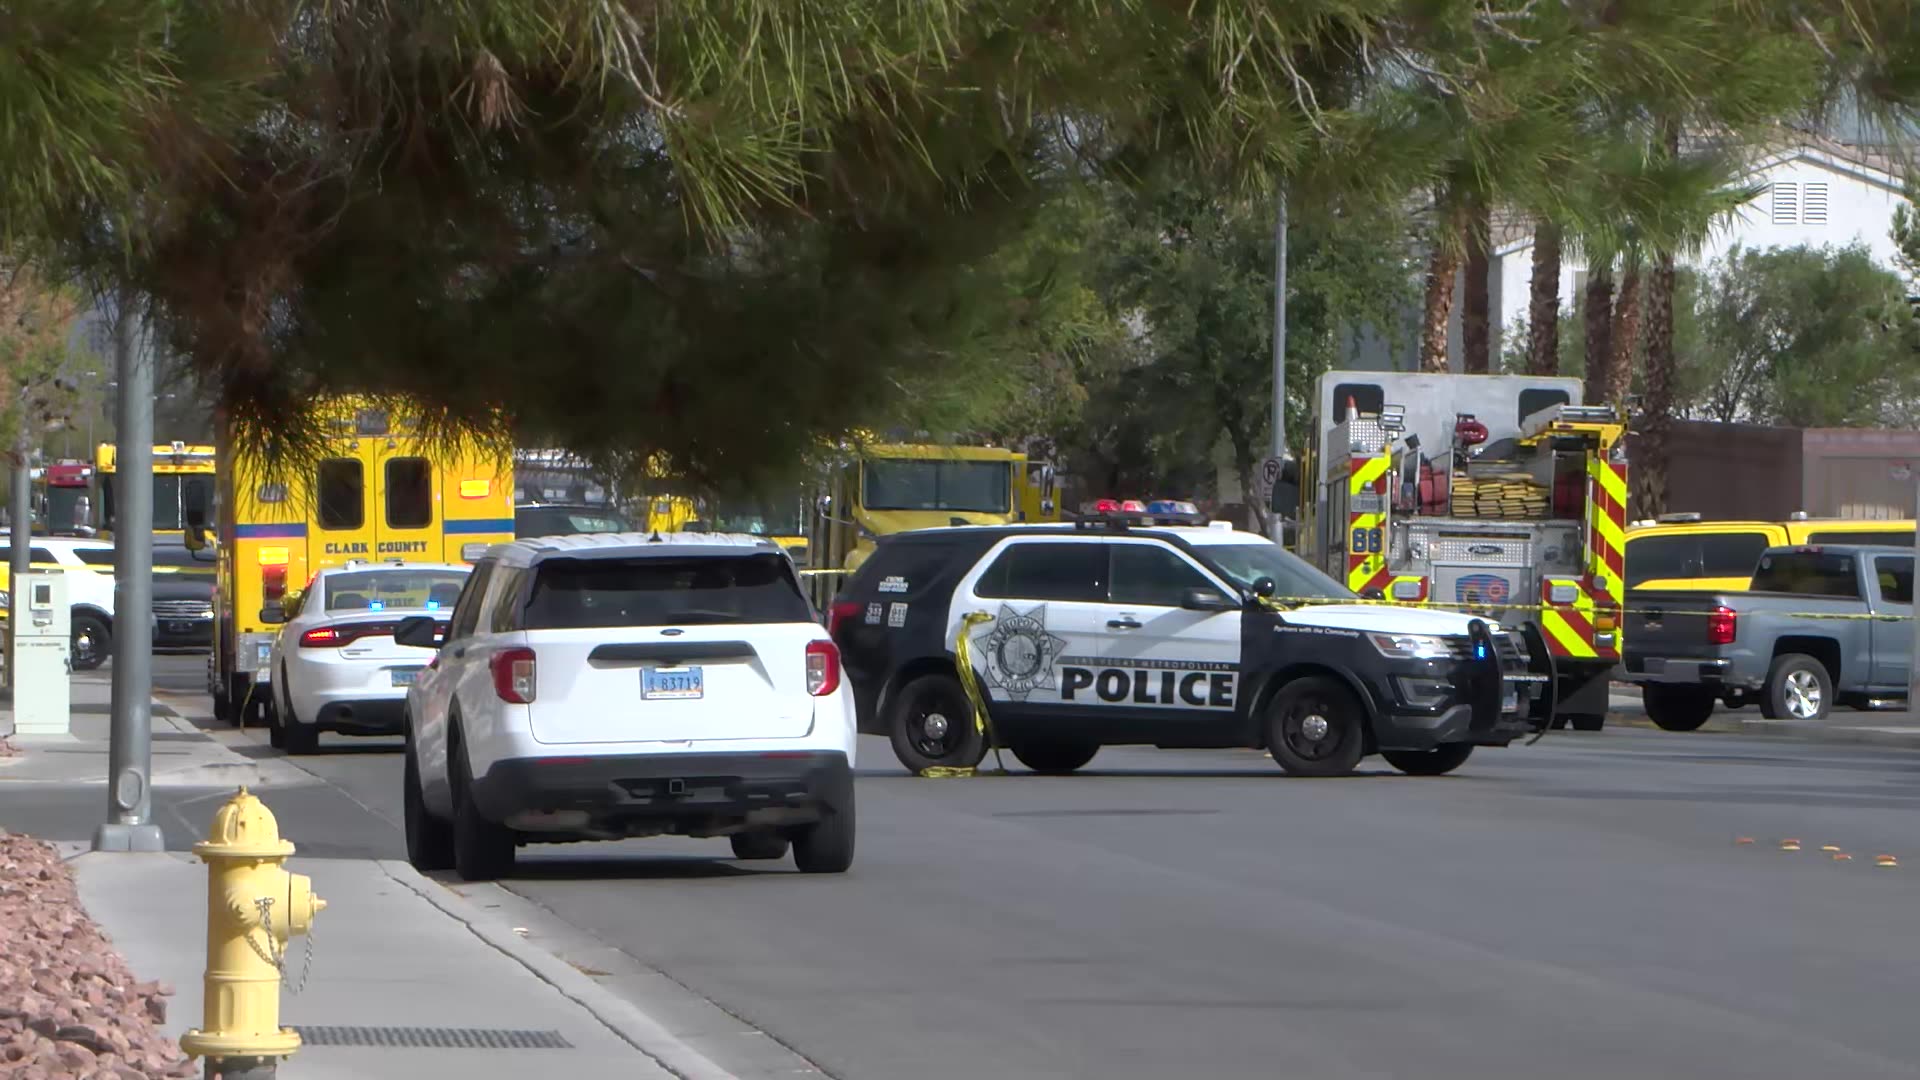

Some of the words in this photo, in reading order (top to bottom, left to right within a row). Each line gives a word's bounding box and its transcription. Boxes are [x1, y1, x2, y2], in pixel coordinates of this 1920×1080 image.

[325, 542, 368, 553] CLARK
[378, 541, 427, 552] COUNTY
[988, 618, 1051, 654] METROPOLITAN
[1324, 628, 1359, 638] Community
[1101, 659, 1136, 667] VEGAS
[1141, 661, 1230, 670] METROPOLITAN
[661, 677, 700, 691] 83719
[1000, 678, 1037, 690] POLICE
[1062, 667, 1233, 707] POLICE
